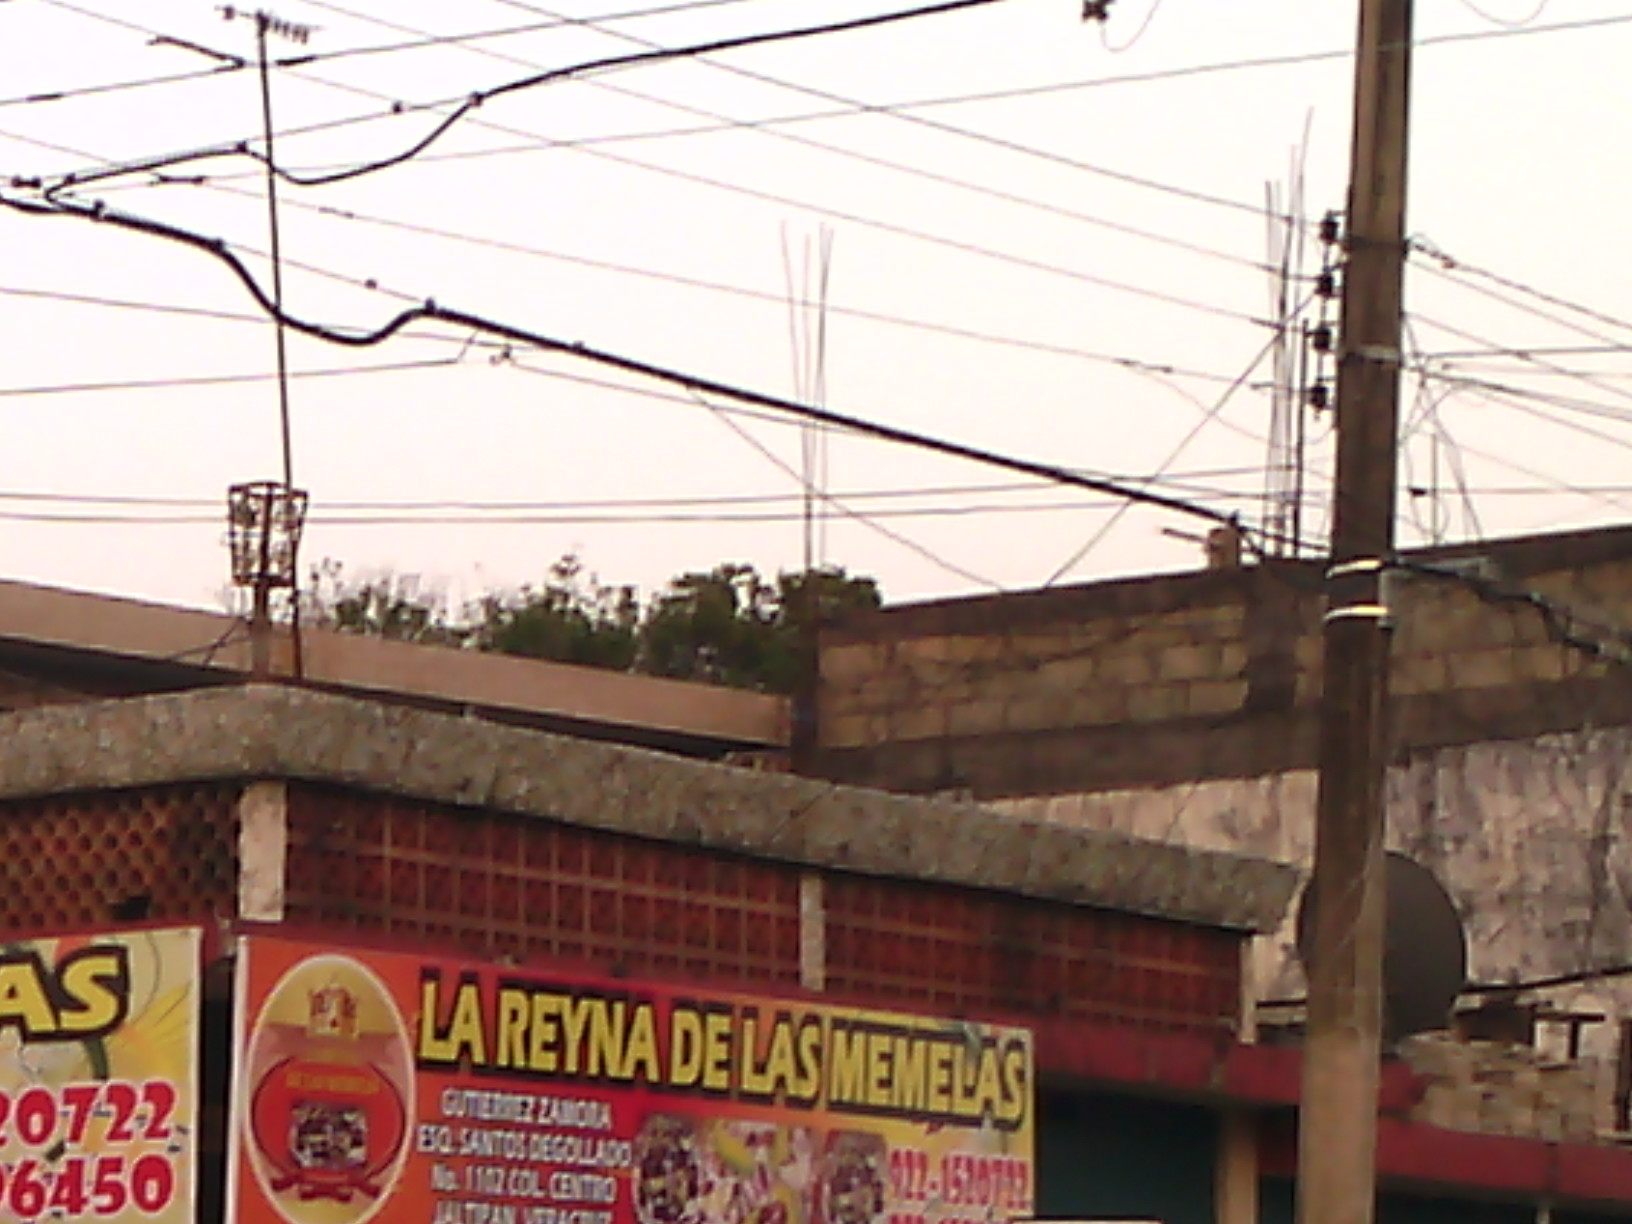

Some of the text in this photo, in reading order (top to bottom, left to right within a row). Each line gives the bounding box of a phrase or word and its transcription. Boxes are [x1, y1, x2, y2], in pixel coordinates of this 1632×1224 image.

[419, 980, 1026, 1120] LA REYNA DE LAS MEMELAS
